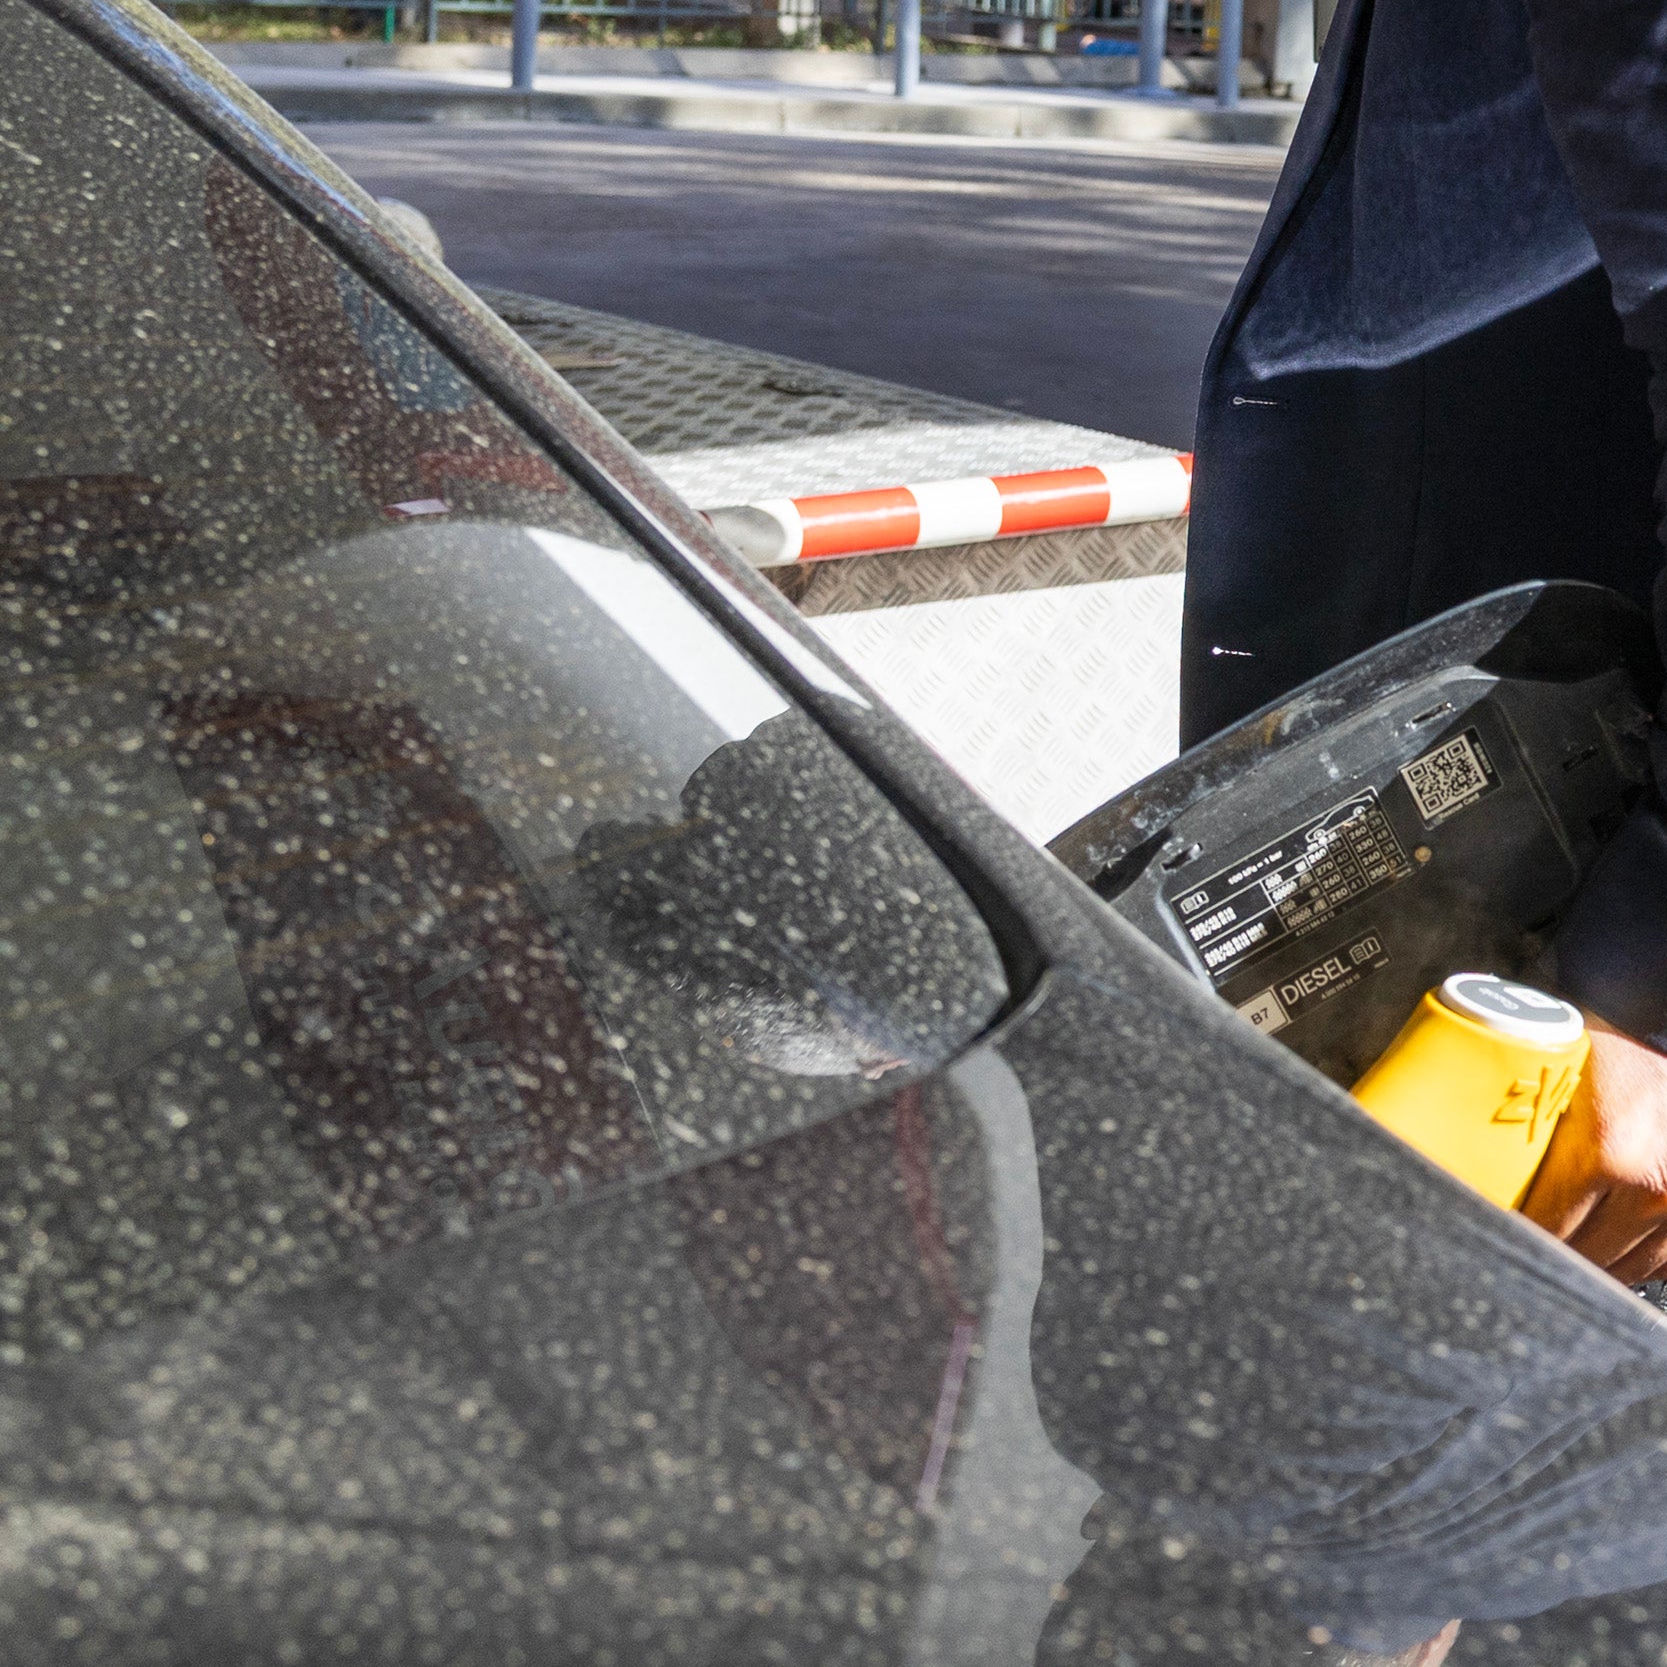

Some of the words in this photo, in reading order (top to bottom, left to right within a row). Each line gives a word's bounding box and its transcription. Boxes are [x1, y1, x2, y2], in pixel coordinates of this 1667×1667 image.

[1308, 847, 1327, 864] 260
[1349, 825, 1367, 840] 260
[1315, 861, 1333, 876] 270
[1355, 838, 1374, 853] 330
[1228, 873, 1243, 885] 100
[1322, 874, 1341, 890] 260
[1361, 851, 1380, 866] 260
[1329, 887, 1348, 902] 280
[1350, 879, 1362, 890] 41
[1368, 864, 1387, 880] 350
[1280, 957, 1352, 1006] DIESEL
[1251, 1008, 1269, 1025] B7
